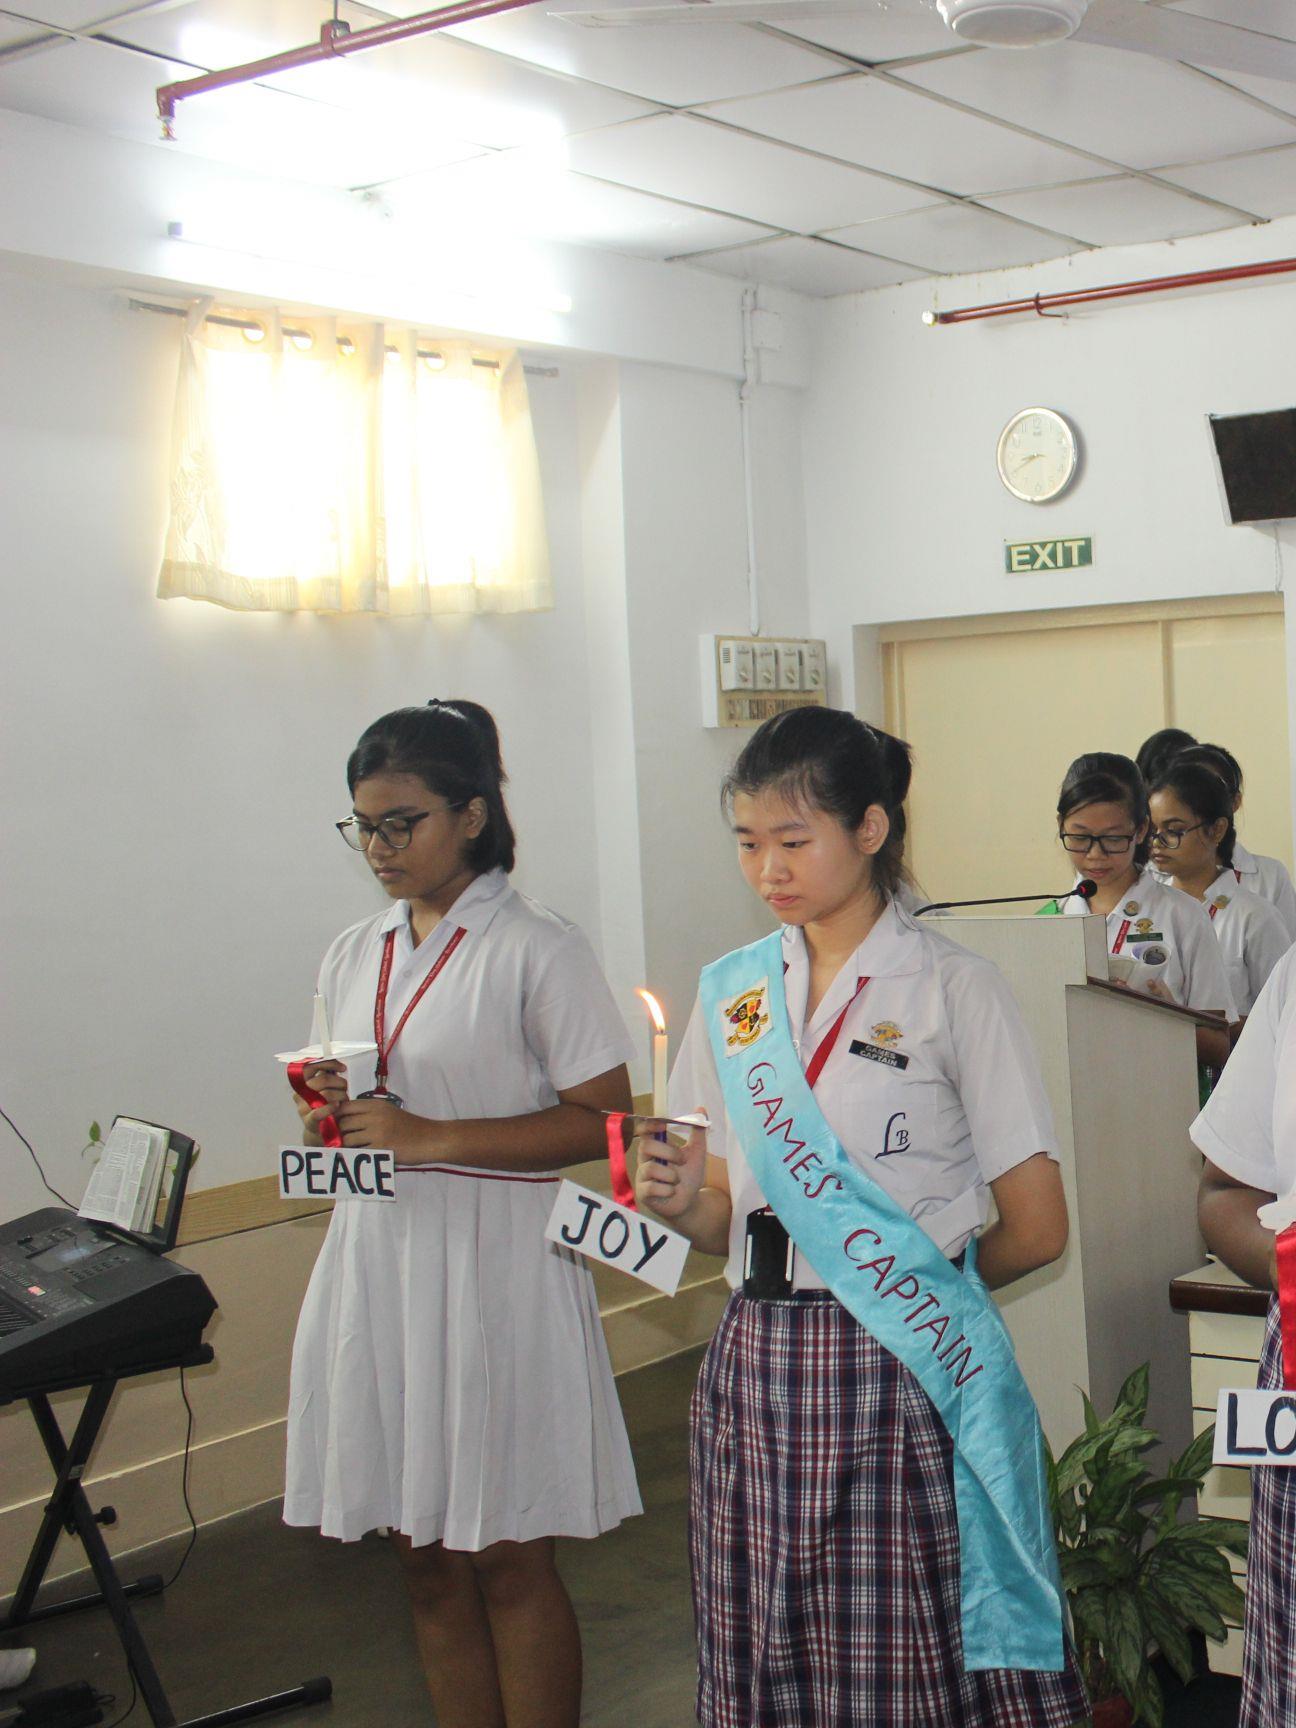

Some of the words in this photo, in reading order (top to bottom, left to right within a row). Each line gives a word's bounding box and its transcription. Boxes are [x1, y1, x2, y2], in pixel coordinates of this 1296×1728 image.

[1010, 540, 1085, 571] EXIT
[860, 1050, 898, 1066] CAPTAIN
[865, 1045, 897, 1060] GAMES
[747, 1062, 843, 1198] GAMES
[281, 1150, 394, 1197] PEACE
[561, 1194, 668, 1272] JOY
[843, 1228, 984, 1388] CAPTAIN
